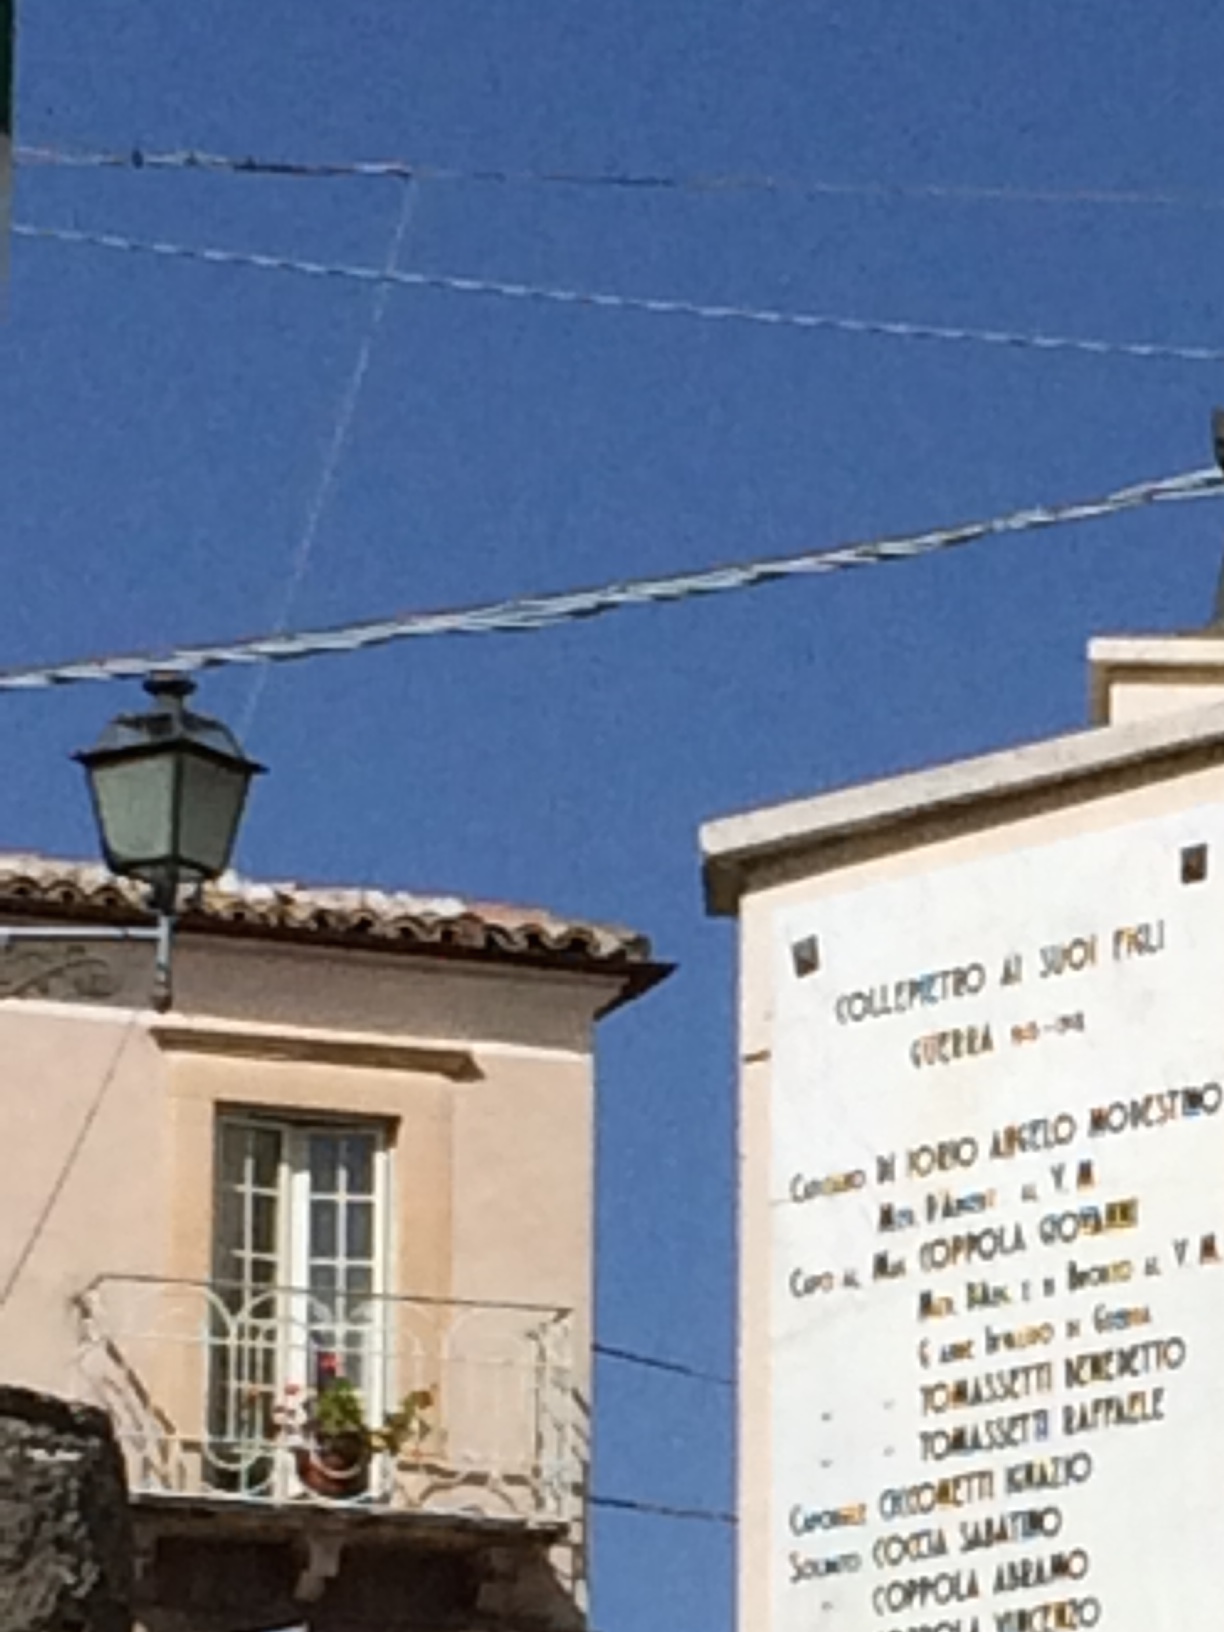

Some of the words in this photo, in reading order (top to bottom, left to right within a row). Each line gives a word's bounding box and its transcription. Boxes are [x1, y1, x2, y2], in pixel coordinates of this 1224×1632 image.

[835, 962, 985, 1024] COLLEPIETRO
[999, 954, 1021, 986] AI
[1039, 934, 1096, 978] SUOI
[1112, 919, 1164, 960] FIGLI
[910, 1023, 993, 1068] GUERRA
[876, 1153, 895, 1184] DI
[989, 1112, 1076, 1159] ANGELO
[1087, 1081, 1222, 1137] MODESTINO
[919, 1223, 1026, 1271] COPPOLA
[919, 1361, 1051, 1415] TOMASSETTI
[1064, 1336, 1185, 1387] BENEDETTO
[919, 1409, 1048, 1460] TOMASSETTI
[1062, 1386, 1164, 1435] RAFFAELE
[1005, 1451, 1091, 1493] IGNAZIO
[872, 1529, 947, 1568] COCCIA
[959, 1506, 1062, 1552] SABATINO
[872, 1570, 979, 1615] COPPOLA
[992, 1547, 1088, 1594] ABRAMO
